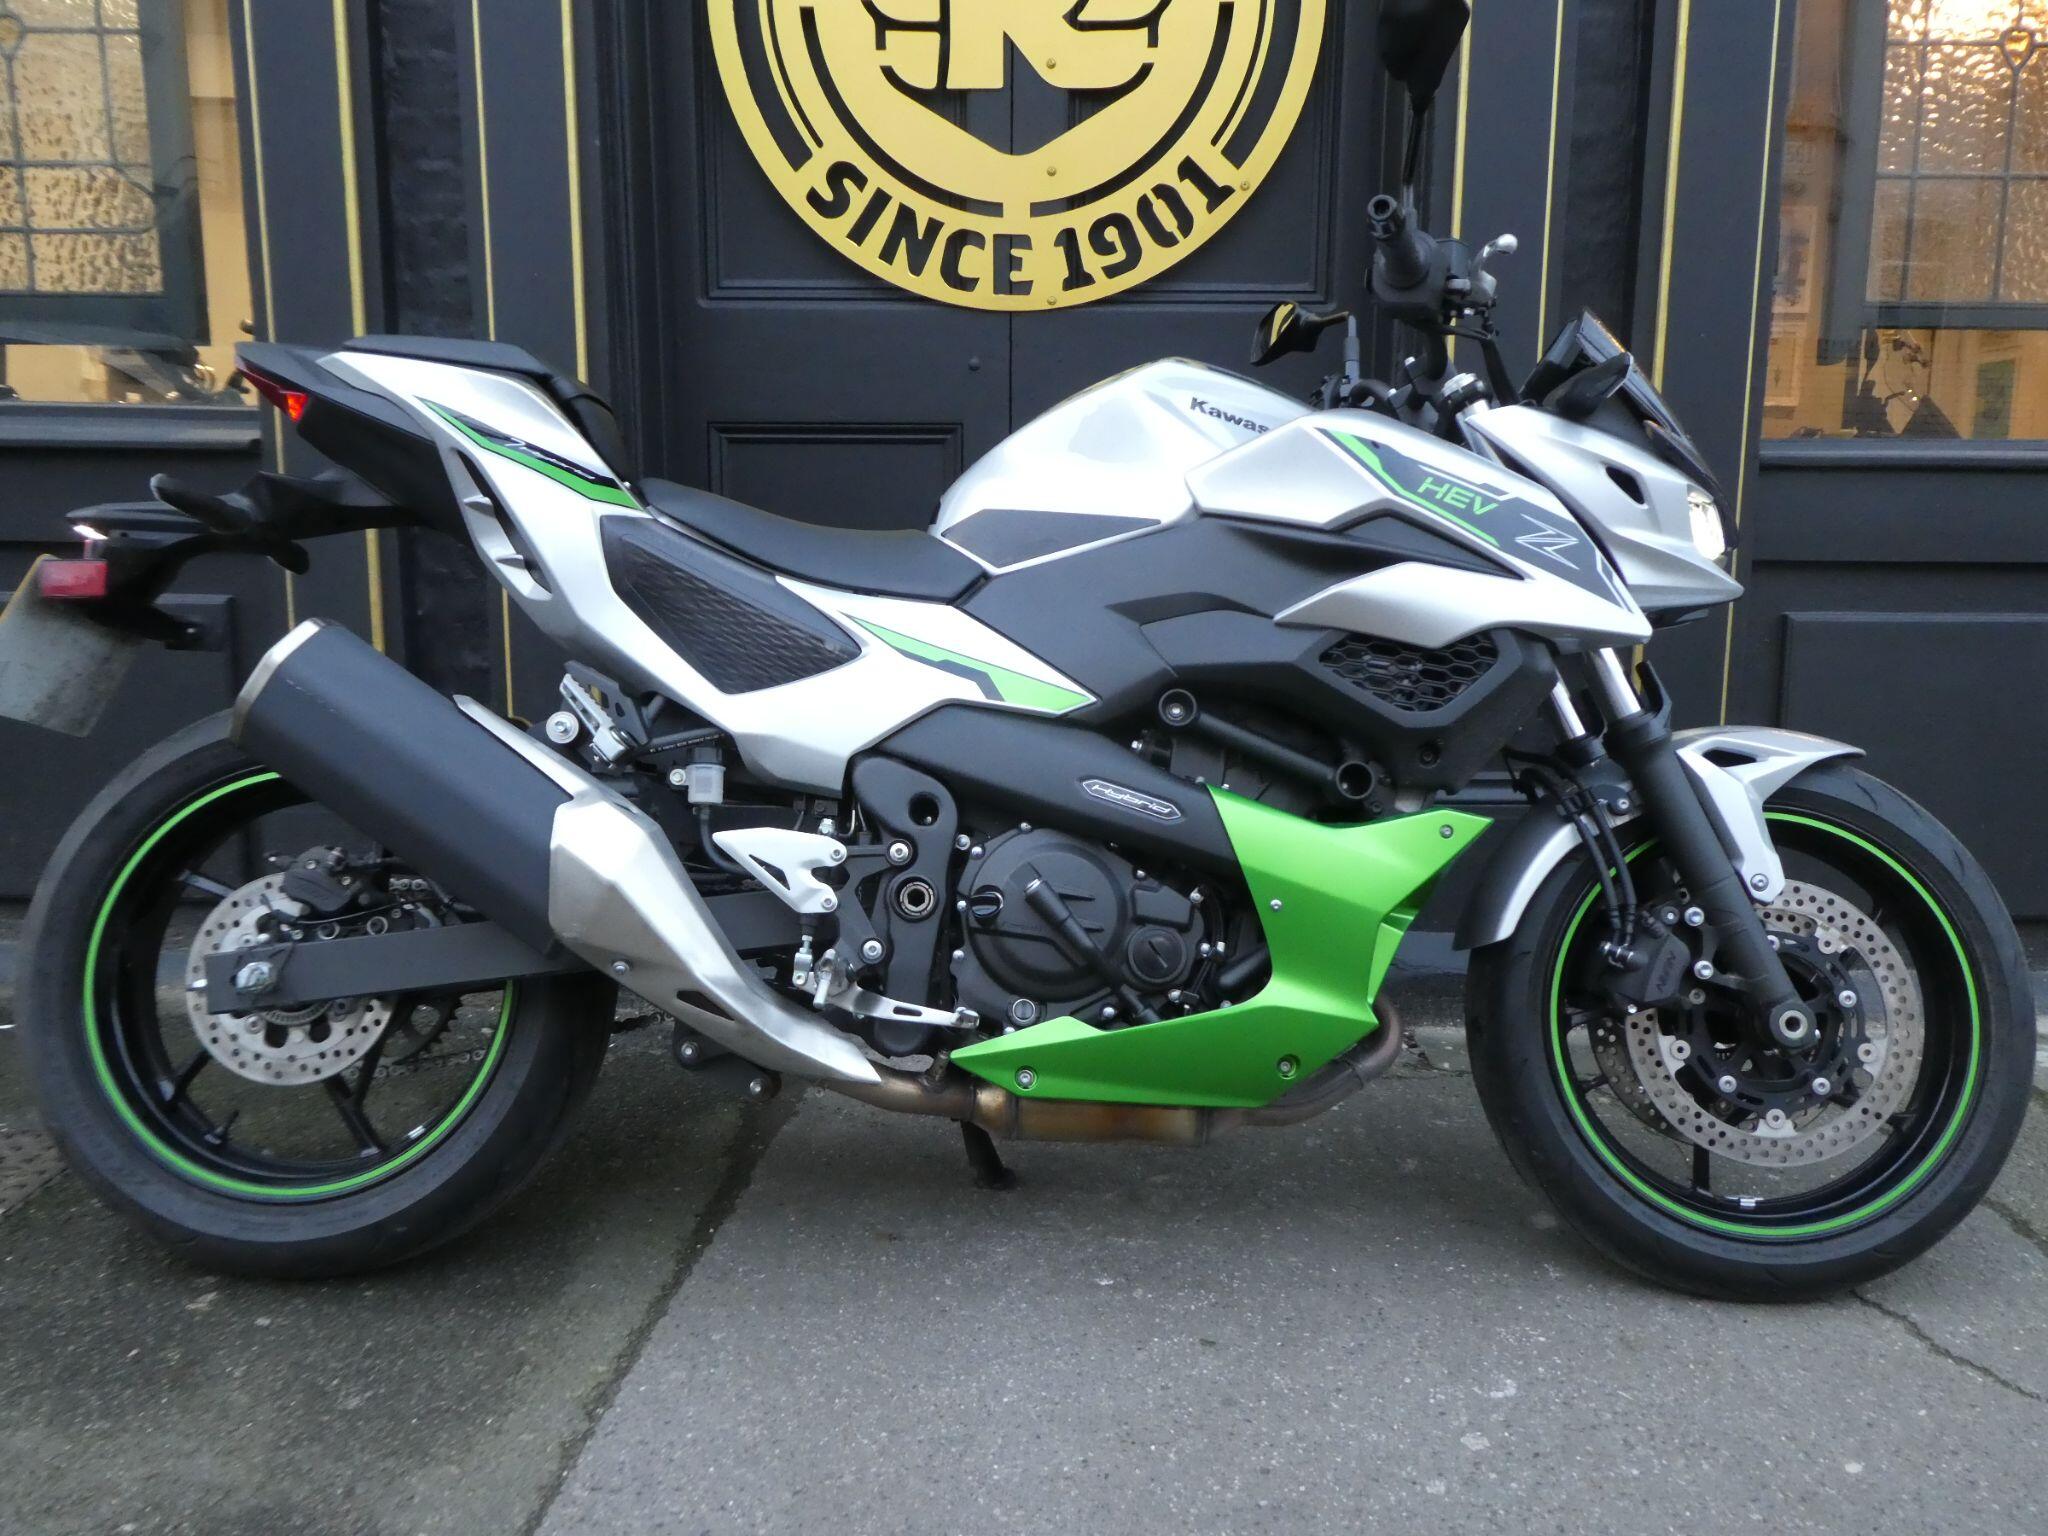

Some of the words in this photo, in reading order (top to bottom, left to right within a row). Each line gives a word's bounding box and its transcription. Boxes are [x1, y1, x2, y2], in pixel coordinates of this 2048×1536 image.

[806, 160, 1034, 296] SINCE
[1053, 154, 1236, 293] 1901
[1417, 476, 1500, 516] HEV
[1091, 784, 1172, 814] Hybrid
